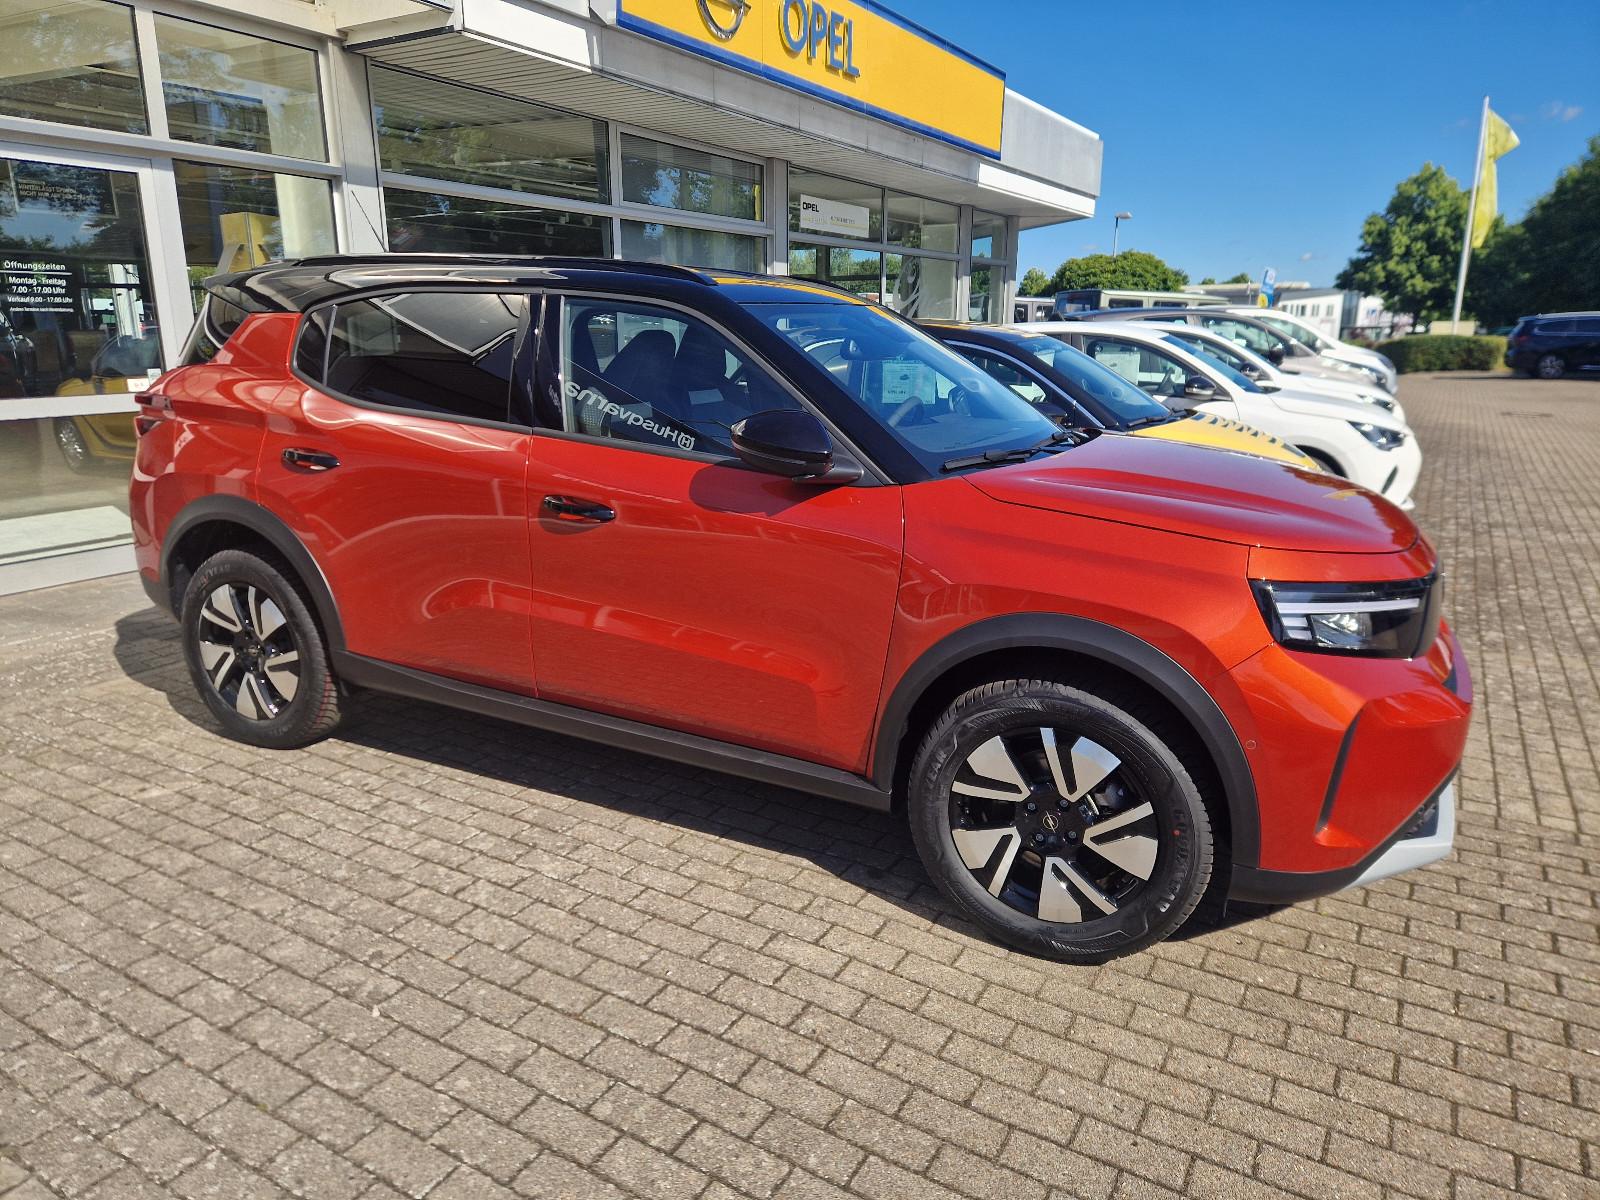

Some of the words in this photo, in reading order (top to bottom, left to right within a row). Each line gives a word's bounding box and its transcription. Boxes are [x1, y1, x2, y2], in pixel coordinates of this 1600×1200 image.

[779, 0, 860, 78] OPEL
[802, 201, 820, 213] OPEL
[4, 260, 66, 271] Öffnungszeiten
[8, 276, 37, 286] Montag
[42, 277, 67, 286] Freitag
[52, 286, 66, 294] Uhr
